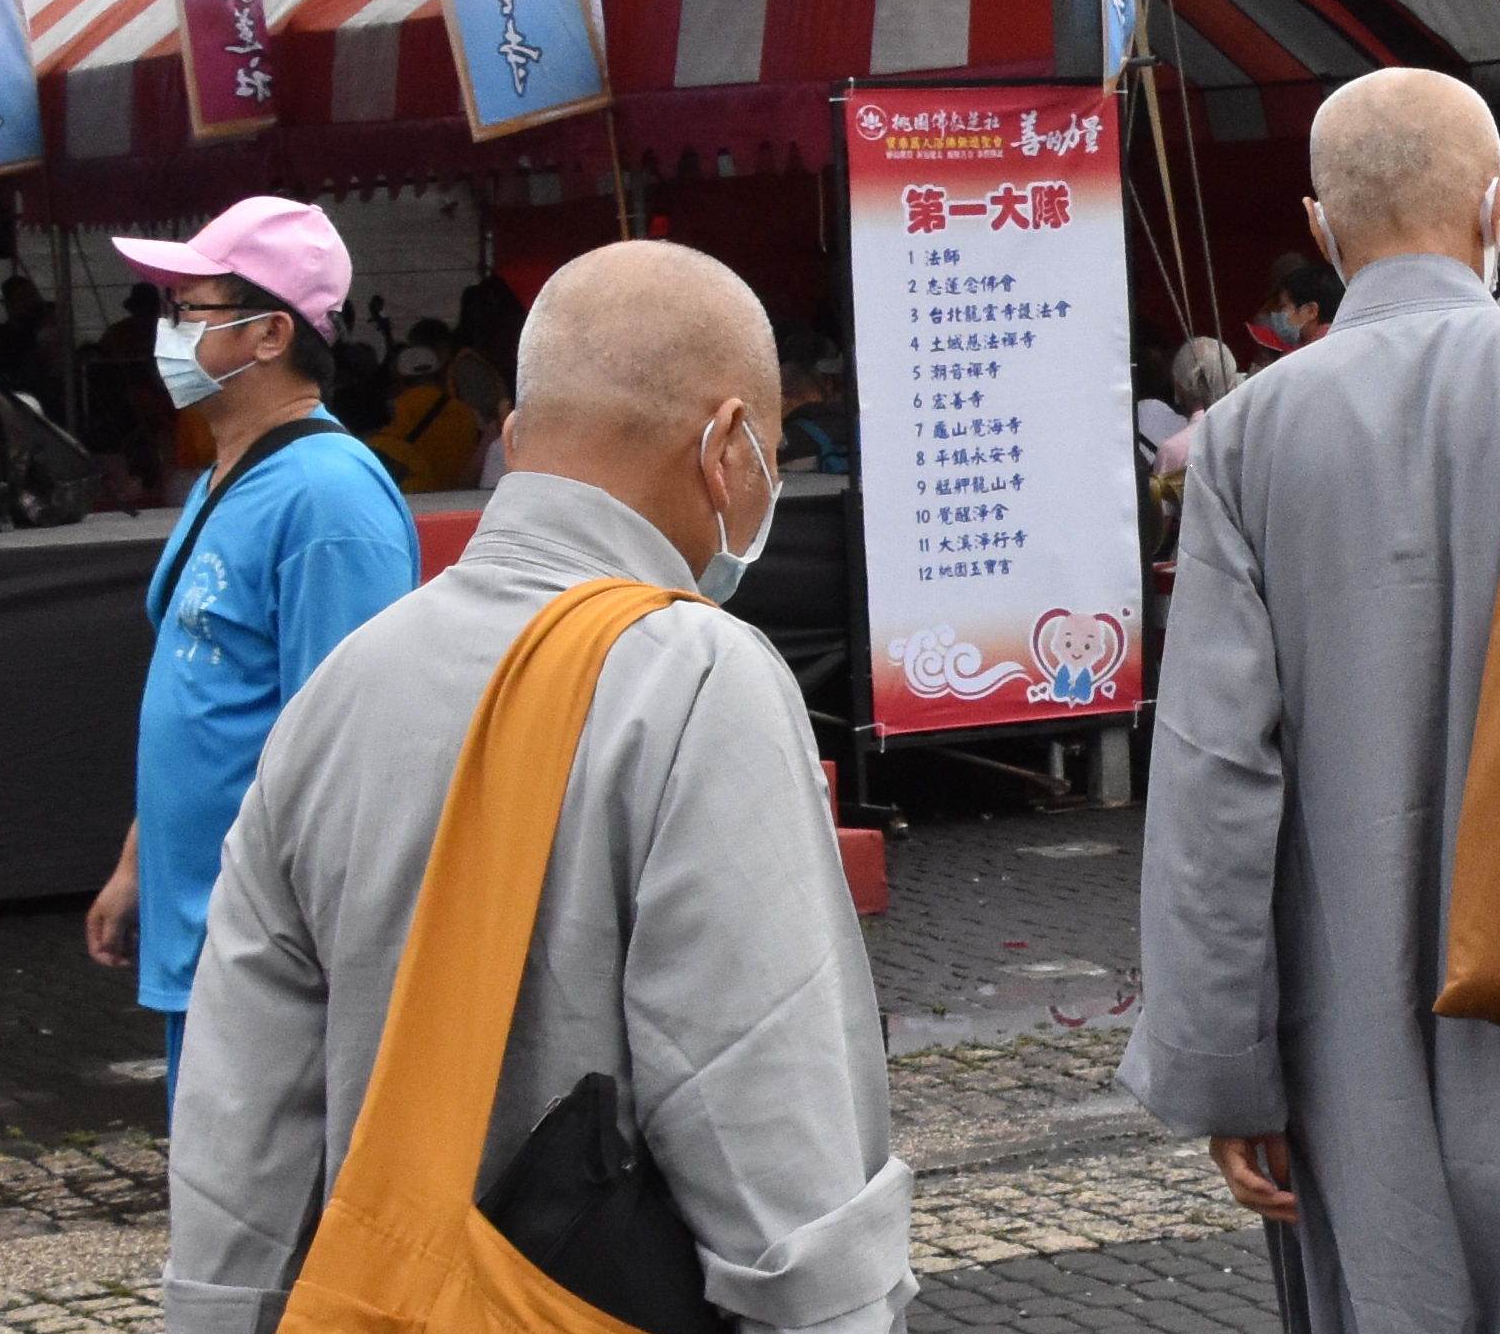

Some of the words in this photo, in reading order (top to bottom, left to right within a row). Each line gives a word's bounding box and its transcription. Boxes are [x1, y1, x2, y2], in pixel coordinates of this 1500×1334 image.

[891, 110, 1001, 137] 桃園佛教蓮社
[1010, 110, 1102, 156] 善的力量
[904, 183, 1071, 234] 第一大隊
[908, 250, 913, 264] 1
[925, 248, 960, 266] 法師
[908, 279, 917, 293] 2
[910, 308, 918, 322] 3
[930, 300, 1071, 324] 台北龍雲寺護法會
[910, 336, 919, 351] 4
[912, 365, 921, 380] 5
[931, 361, 1001, 381] 潮音禪寺
[913, 393, 922, 408] 6
[915, 423, 923, 437] 7
[916, 451, 925, 466] 8
[935, 445, 1023, 467] 平鎮永安寺
[917, 480, 926, 495] 9
[936, 473, 1024, 496] 艋舺龍山寺
[916, 509, 930, 524] 10
[919, 538, 929, 552] 11
[938, 530, 1028, 553] 大溪淨行寺
[919, 567, 932, 581] 12
